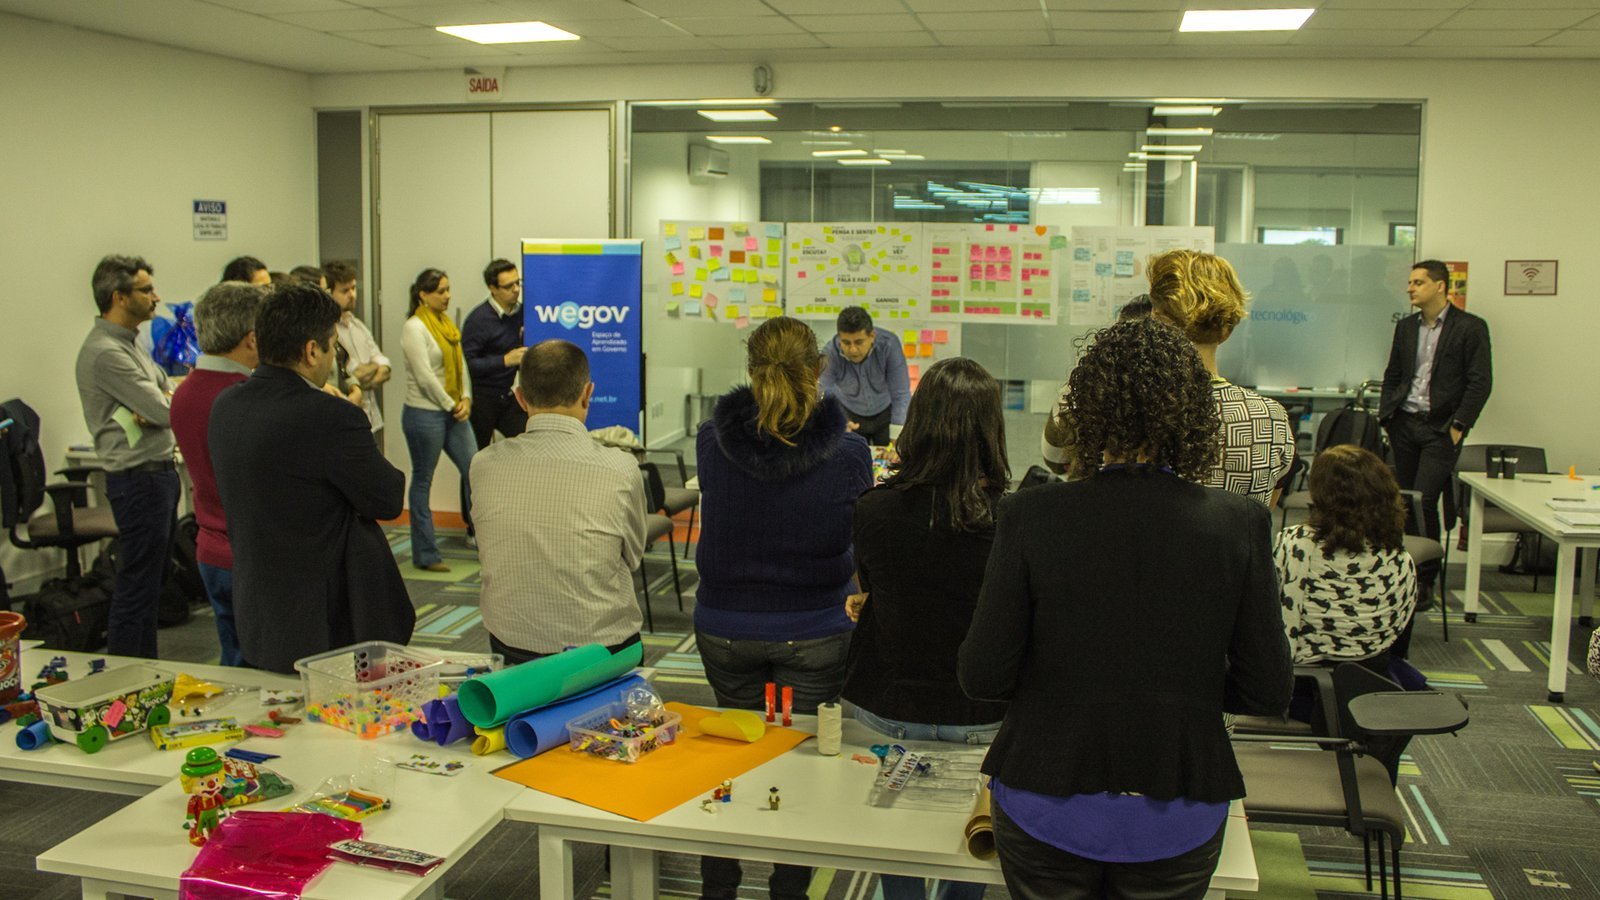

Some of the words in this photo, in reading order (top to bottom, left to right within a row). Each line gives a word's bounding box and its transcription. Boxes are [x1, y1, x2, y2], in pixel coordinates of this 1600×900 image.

[197, 202, 222, 212] AVISO
[534, 304, 629, 329] wegov
[592, 331, 612, 339] Espaço
